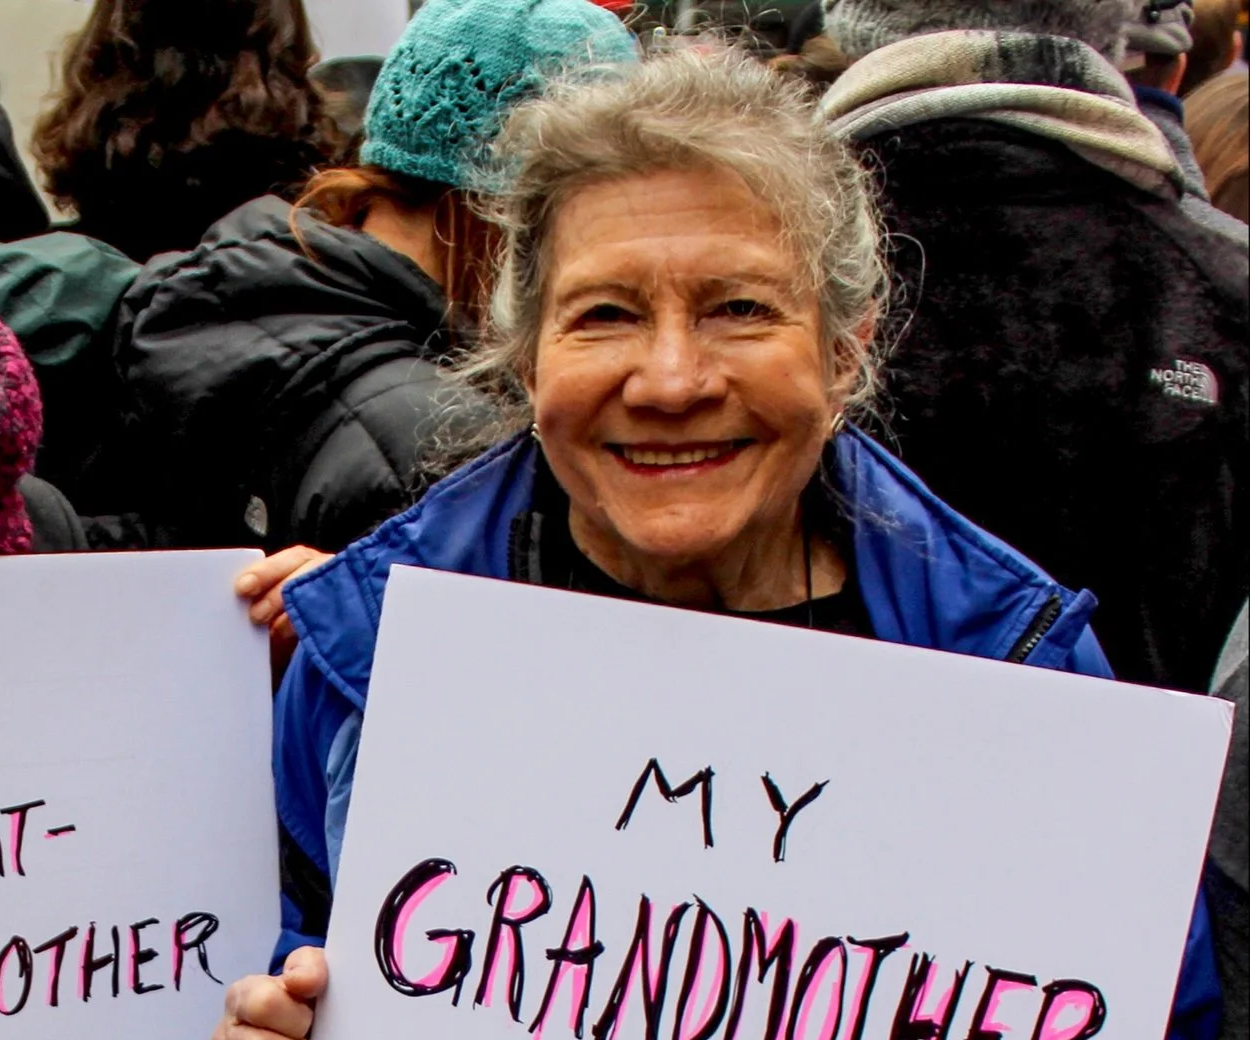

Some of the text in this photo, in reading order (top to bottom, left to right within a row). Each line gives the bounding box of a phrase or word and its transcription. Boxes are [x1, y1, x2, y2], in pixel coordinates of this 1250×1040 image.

[1175, 359, 1201, 373] THE
[1150, 368, 1200, 385] NORTH
[1163, 383, 1200, 399] FACE
[616, 758, 829, 862] MY
